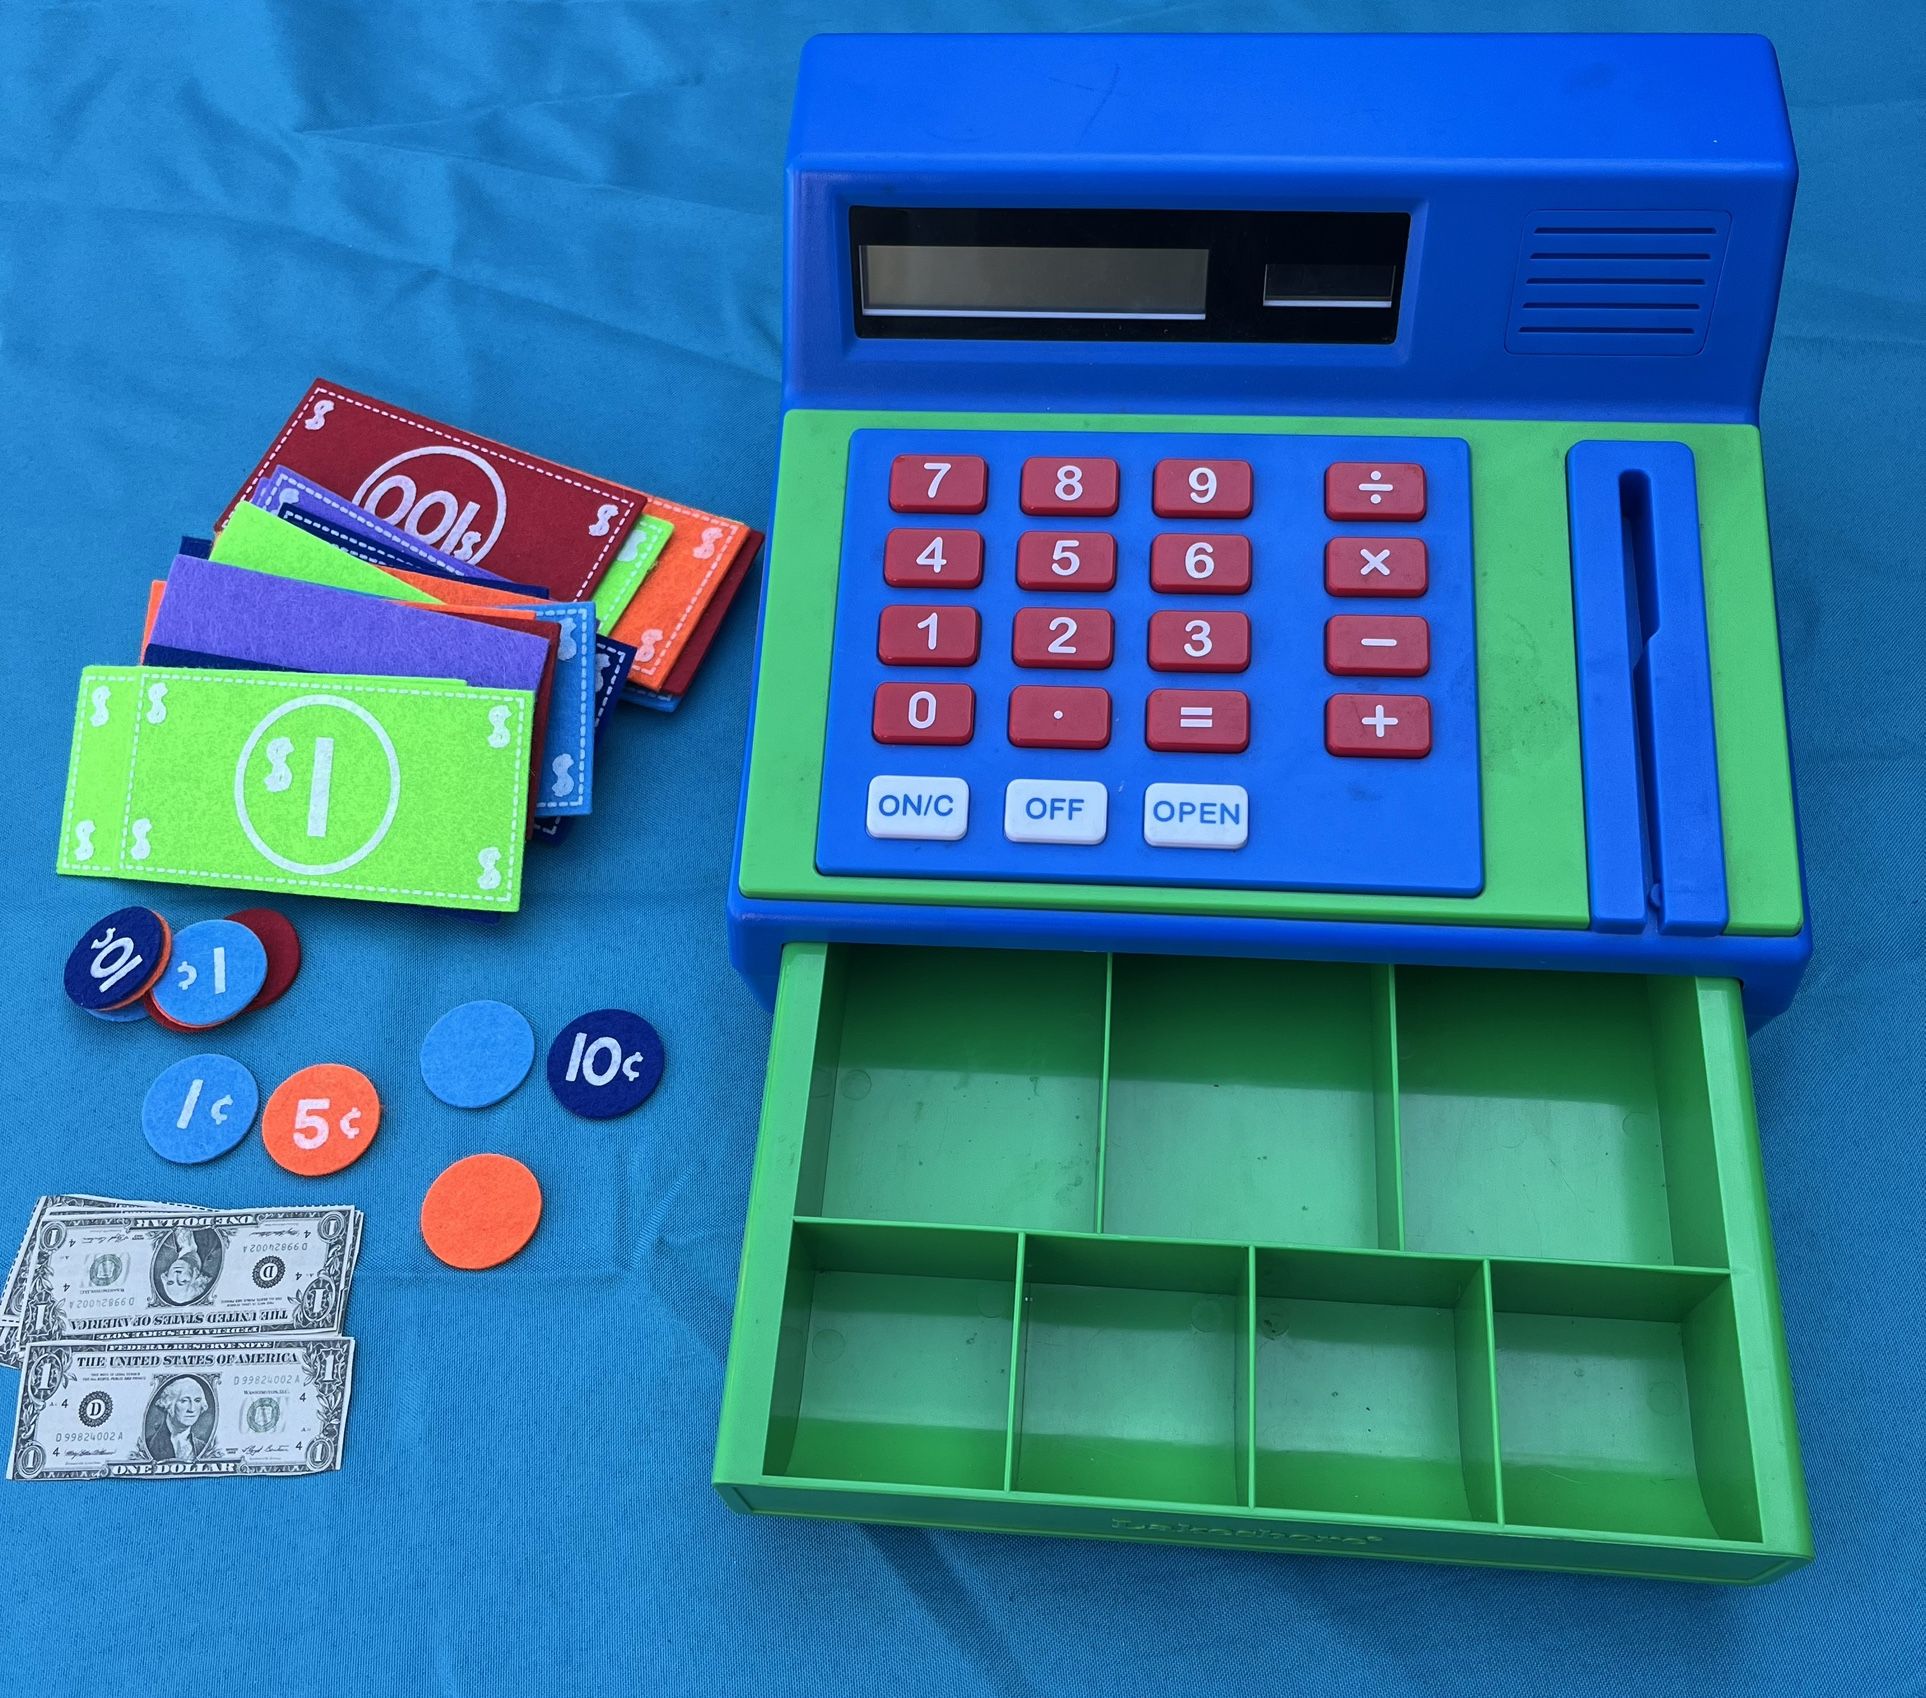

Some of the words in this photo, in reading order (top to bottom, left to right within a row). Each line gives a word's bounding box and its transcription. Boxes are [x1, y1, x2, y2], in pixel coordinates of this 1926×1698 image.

[305, 400, 334, 430] $
[923, 462, 951, 498] 7
[1055, 465, 1084, 500] 8
[1188, 467, 1217, 504] 9
[589, 504, 619, 536] $
[915, 536, 947, 573] 4
[1051, 540, 1080, 576] 5
[1185, 542, 1214, 579] 6
[916, 612, 938, 650] 1
[1047, 616, 1077, 654] 2
[1183, 619, 1213, 658] 3
[90, 685, 111, 727] $
[146, 682, 168, 724] $
[908, 691, 937, 730] 0
[488, 705, 512, 748] $
[1361, 704, 1398, 737] +
[264, 737, 334, 837] $1
[878, 793, 954, 818] ON/C
[1025, 798, 1084, 821] OFF
[1153, 801, 1240, 825] OPEN
[75, 819, 96, 861] $
[131, 818, 153, 861] $
[477, 847, 501, 889] $
[566, 1033, 643, 1086] 10¢
[177, 1079, 234, 1129] 1¢
[293, 1098, 362, 1150] 5¢
[136, 1217, 213, 1227] DOLLAR
[215, 1215, 254, 1225] ONE
[328, 1219, 337, 1236] 1
[50, 1230, 58, 1246] 1
[313, 1288, 327, 1313] 1
[36, 1304, 46, 1330] 1
[71, 1318, 130, 1330] AMERICA
[133, 1317, 151, 1327] OF
[153, 1315, 204, 1325] STATES
[207, 1312, 257, 1323] UNITED
[260, 1310, 288, 1320] THE
[77, 1357, 105, 1367] THE
[110, 1356, 160, 1366] UNITED
[163, 1355, 214, 1366] STATES
[216, 1354, 235, 1364] OF
[238, 1352, 298, 1364] AMERICA
[324, 1354, 334, 1381] 1
[39, 1363, 51, 1390] 1
[61, 1399, 69, 1408] 4
[90, 1402, 102, 1416] D
[300, 1393, 307, 1402] 4
[53, 1447, 60, 1456] 4
[295, 1441, 303, 1450] 4
[314, 1444, 322, 1462] 1
[26, 1450, 35, 1469] 1
[112, 1464, 152, 1475] ONE
[156, 1463, 236, 1474] DOLLAR
